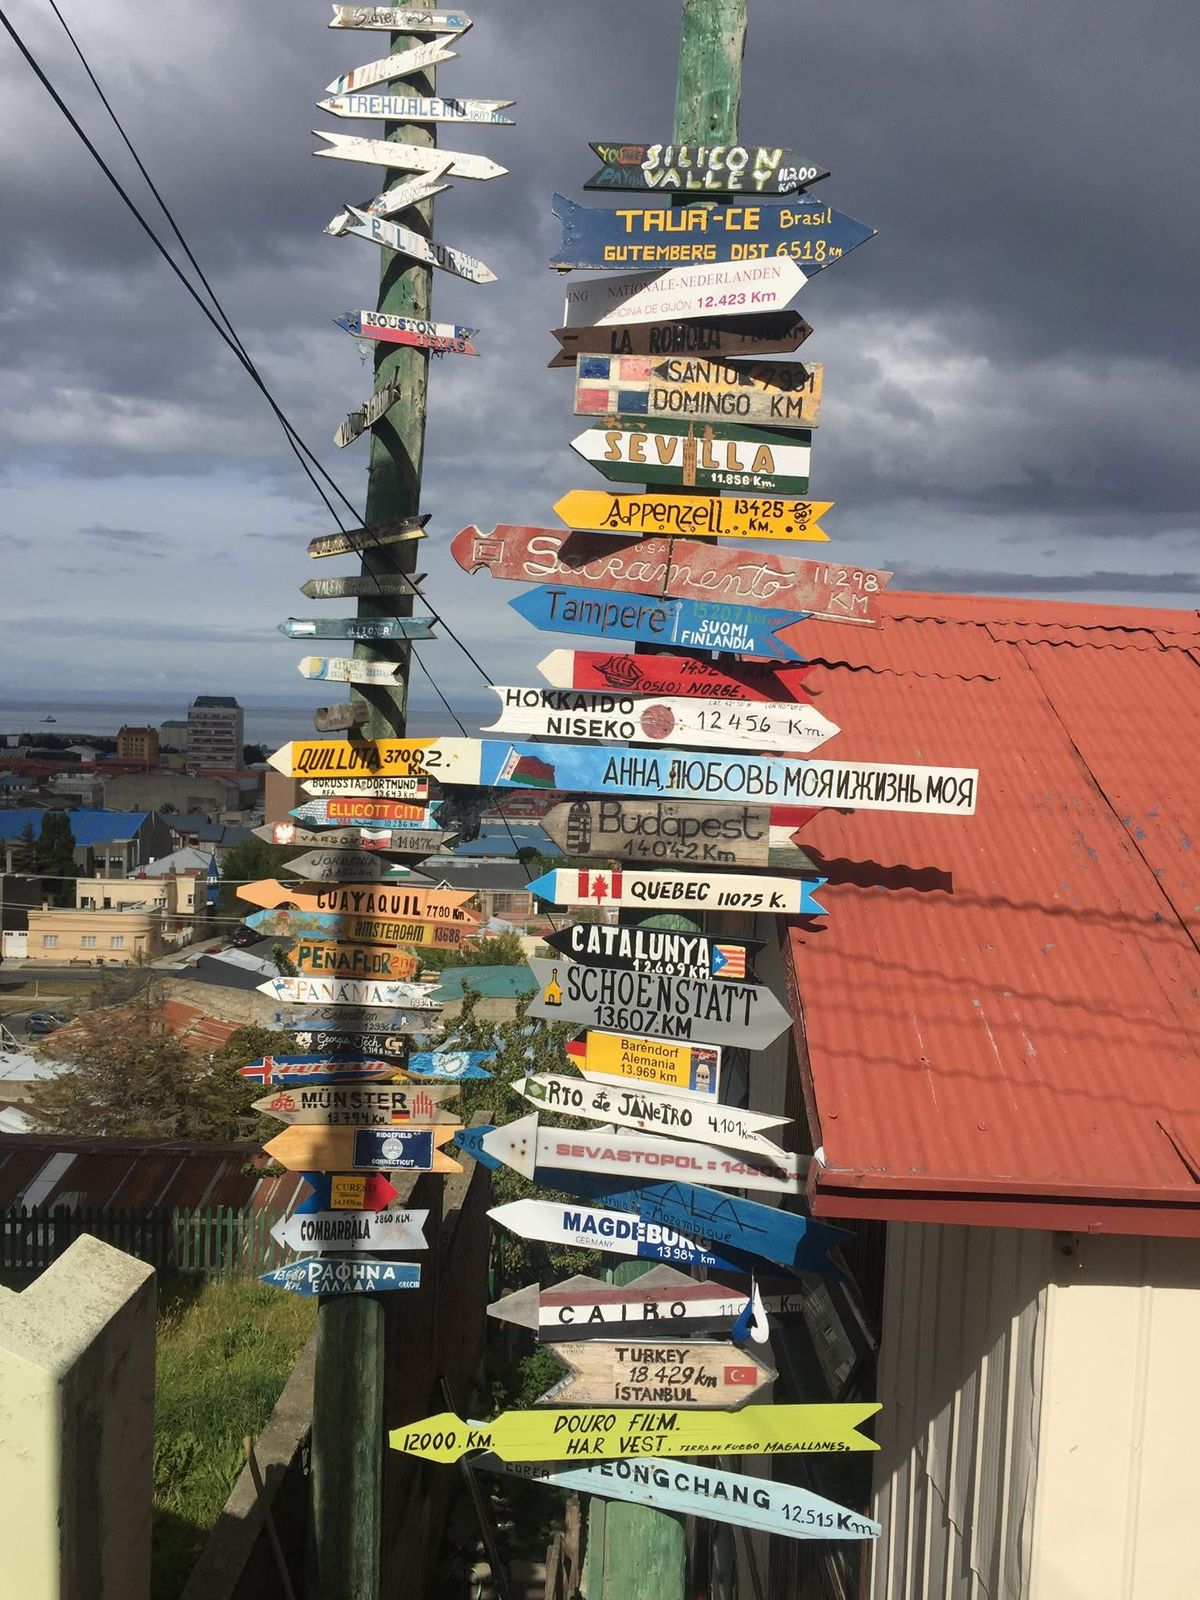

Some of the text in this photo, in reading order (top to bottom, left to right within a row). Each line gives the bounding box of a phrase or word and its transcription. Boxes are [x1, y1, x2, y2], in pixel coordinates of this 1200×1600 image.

[641, 143, 783, 170] SILICON
[644, 168, 772, 192] VALLEY
[779, 207, 832, 229] Brasil
[604, 244, 717, 261] GUTEMBERG
[730, 243, 770, 261] DIST
[776, 239, 827, 262] 6518
[607, 266, 782, 297] NATIONALE-NEDERLANDEN
[697, 294, 747, 309] 12.423
[366, 311, 437, 335] HOUSTON
[417, 334, 466, 353] TEXAS
[611, 329, 632, 354] LA
[653, 388, 804, 419] DOMINGO KM
[734, 499, 785, 518] 13425
[523, 536, 797, 599] Sacramento
[546, 590, 667, 633] Tampere
[829, 591, 870, 613] KM
[699, 619, 749, 637] SUOMI
[681, 630, 755, 651] FINLANDIA
[505, 688, 635, 714] HOKKAIDO
[546, 717, 636, 739] NISEKO
[366, 779, 416, 790] DORTMUND
[925, 775, 974, 808] МОЯ
[329, 802, 424, 820] ELLICOTT CITY
[599, 801, 766, 845] Budapest
[300, 834, 377, 846] VARSOVIA
[354, 920, 425, 943] AMSTERDAM
[571, 923, 711, 968] CATALUNYA
[297, 945, 392, 974] PEÑAFLOR
[567, 966, 759, 1027] SCHOENSTATT
[353, 1034, 382, 1049] Tech
[621, 1038, 679, 1059] Barendorf
[621, 1052, 676, 1070] Alemania
[620, 1064, 678, 1083] 13.969 km
[302, 1088, 408, 1110] MÜNSTER
[371, 1158, 415, 1166] CONNECTICUT
[556, 1143, 703, 1171] SEVASTOPOL
[563, 1211, 711, 1252] MAGDEBURG
[574, 1235, 615, 1248] GERMANY
[558, 1301, 687, 1325] CAIRO
[614, 1347, 690, 1364] TURKEY
[553, 1413, 617, 1435] DOURO
